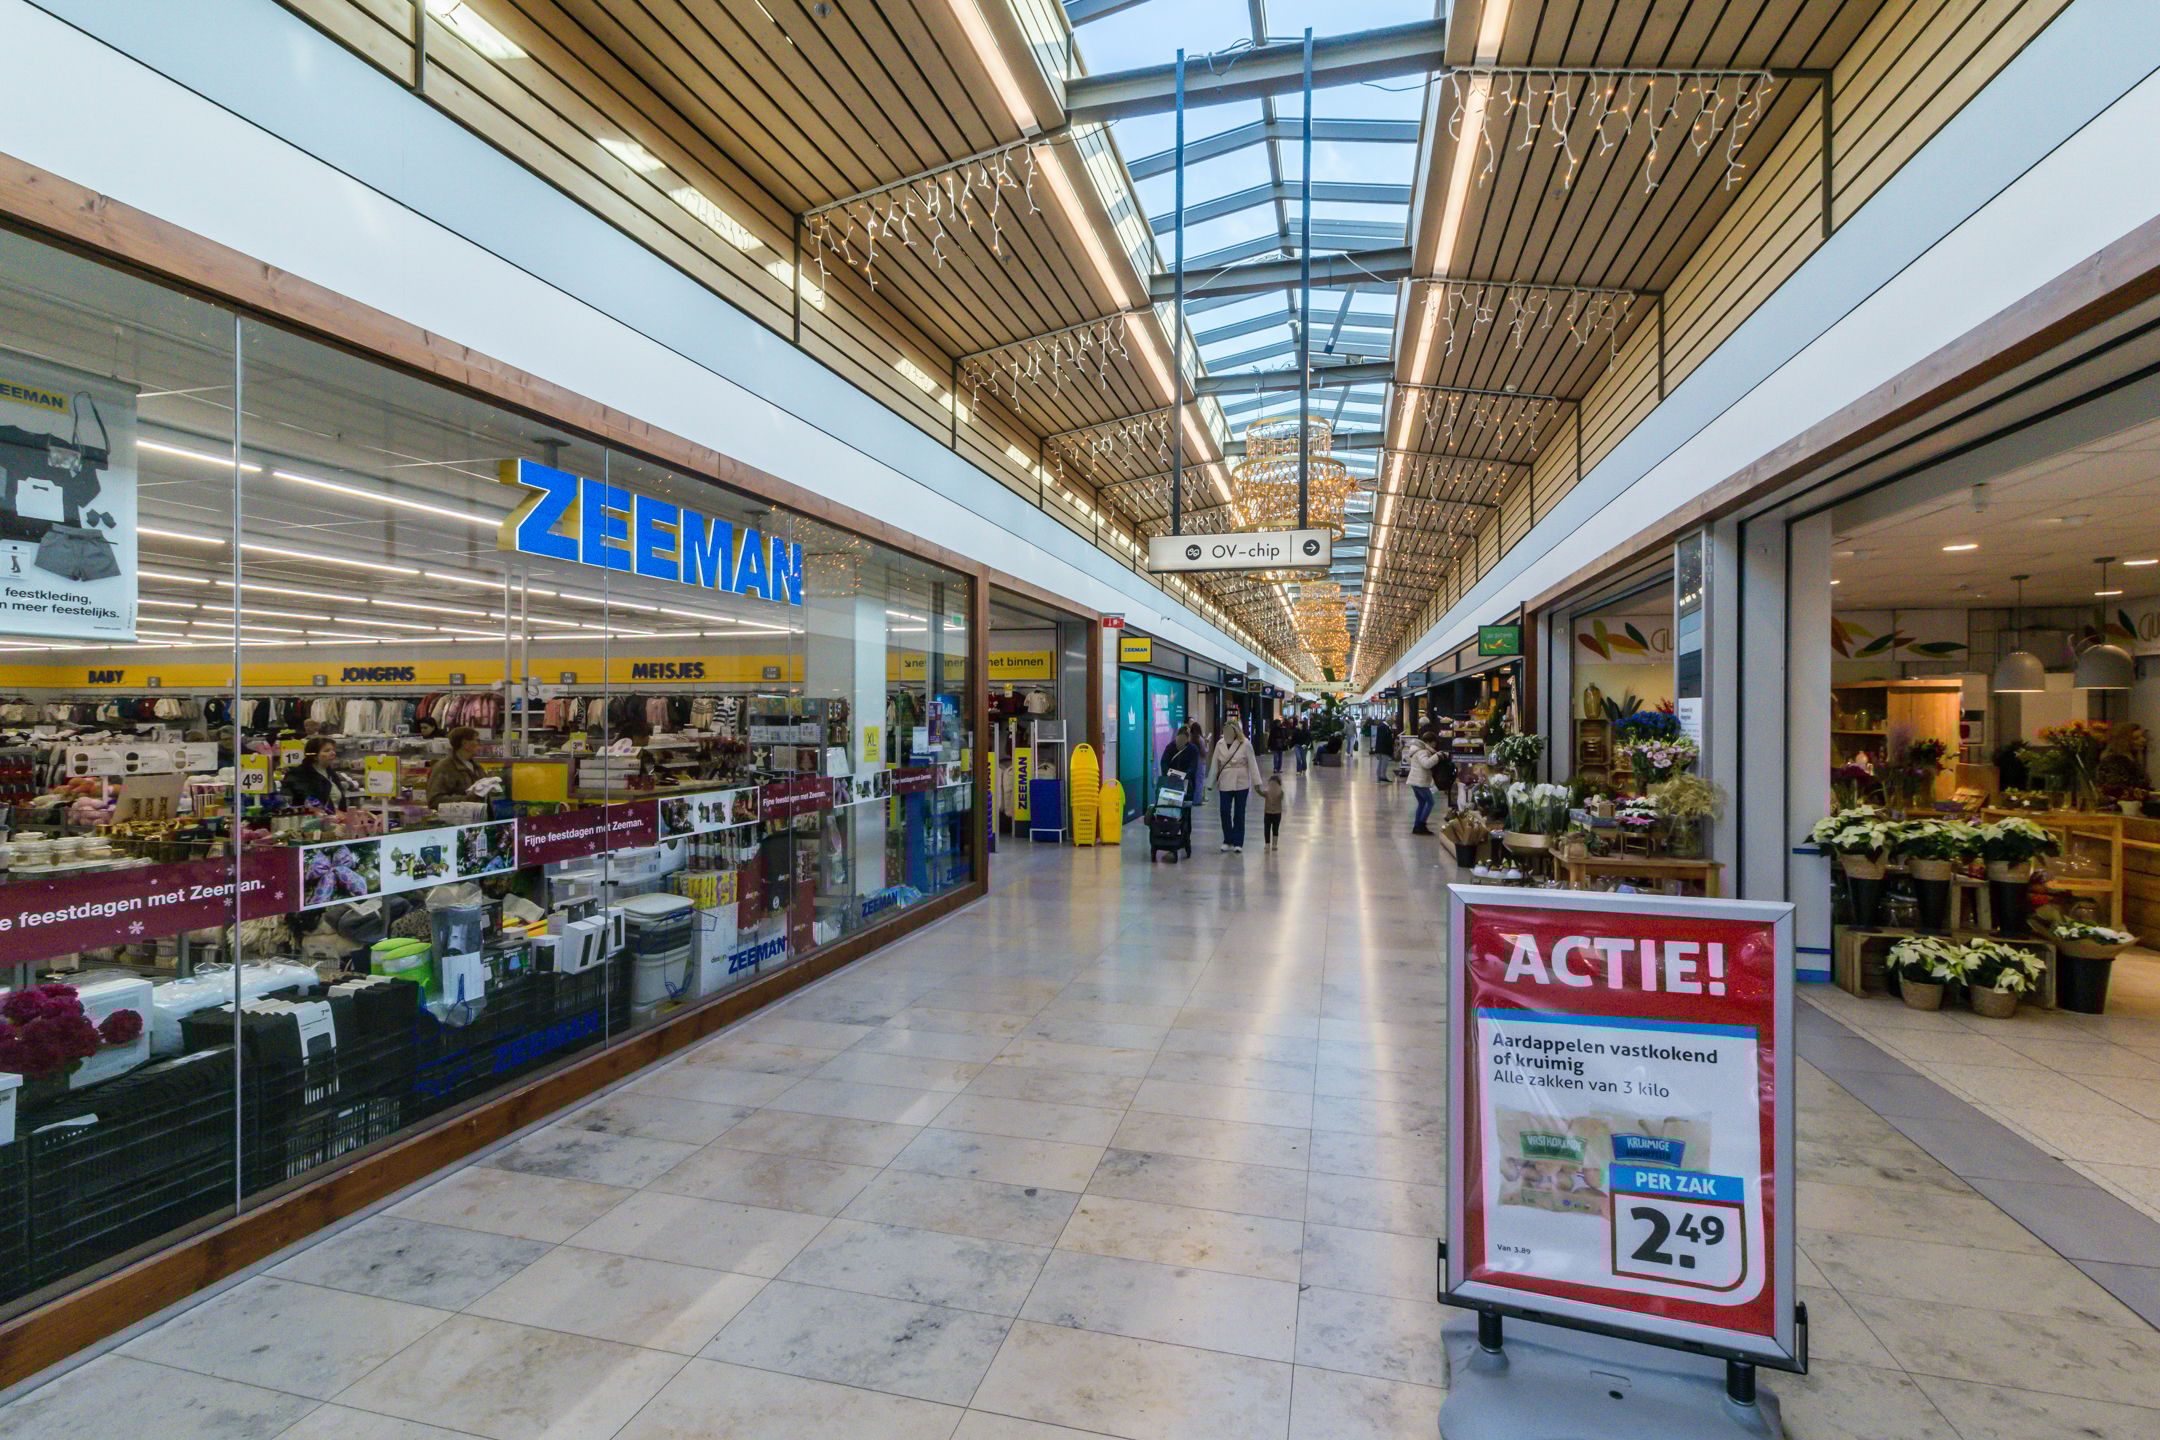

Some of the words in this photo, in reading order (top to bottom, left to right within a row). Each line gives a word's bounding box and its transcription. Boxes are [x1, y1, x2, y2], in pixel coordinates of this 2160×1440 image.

[515, 458, 802, 607] ZEEMAN
[1212, 542, 1280, 561] OV-chip
[5, 587, 92, 606] feestkleding,
[12, 603, 49, 612] meer
[52, 604, 120, 618] feestelijks.
[631, 662, 705, 679] MEISJES
[1007, 656, 1044, 667] binnen
[88, 670, 125, 684] BABY
[340, 666, 416, 683] JONGENS
[1018, 756, 1028, 810] ZEEMAN
[524, 835, 547, 848] Fijne
[548, 826, 595, 843] feestdagen
[612, 819, 644, 831] Zeeman.
[19, 898, 142, 928] feestdagen
[148, 889, 185, 907] met
[190, 880, 266, 901] Zeeman.
[728, 935, 787, 975] ZEEMAN
[1504, 933, 1726, 997] ACTIE!
[1492, 1032, 1605, 1056] Aardappelen
[1609, 1044, 1718, 1064] vastkokend
[1493, 1052, 1512, 1066] of
[1516, 1053, 1585, 1076] kruimig
[1493, 1069, 1524, 1085] Alle
[1529, 1074, 1584, 1090] zakken
[1588, 1081, 1618, 1093] van
[1623, 1081, 1633, 1094] 3
[1638, 1082, 1669, 1098] kilo
[1627, 1136, 1670, 1152] KRUIMIGE
[1635, 1171, 1672, 1192] PER
[1676, 1174, 1717, 1197] ZAK
[1496, 1243, 1511, 1252] Van
